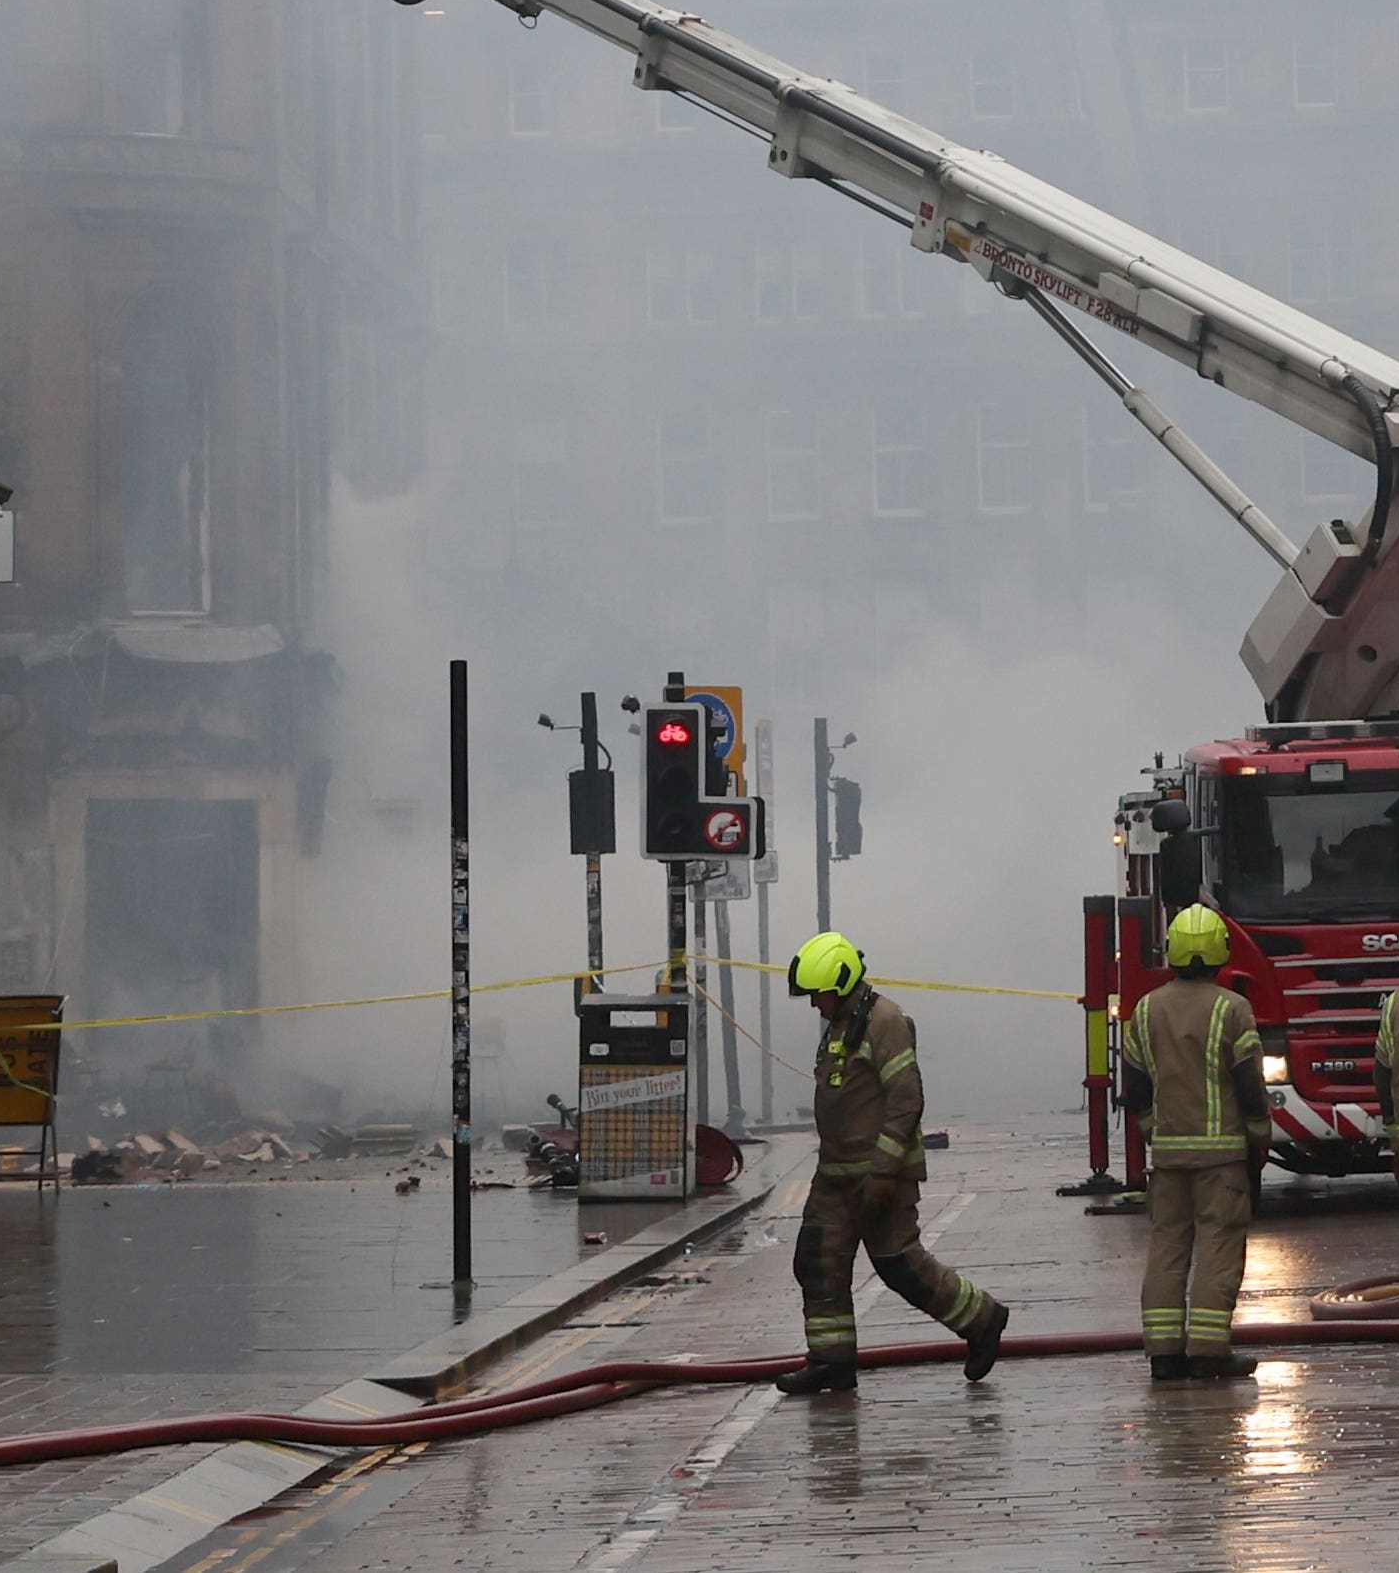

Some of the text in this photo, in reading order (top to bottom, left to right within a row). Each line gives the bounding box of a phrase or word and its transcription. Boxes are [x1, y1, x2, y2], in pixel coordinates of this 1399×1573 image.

[982, 242, 1033, 278] BRONTO
[1033, 269, 1082, 305] SKYLIFT
[1311, 1061, 1322, 1072] P
[585, 1073, 682, 1108] Bin your litter!
